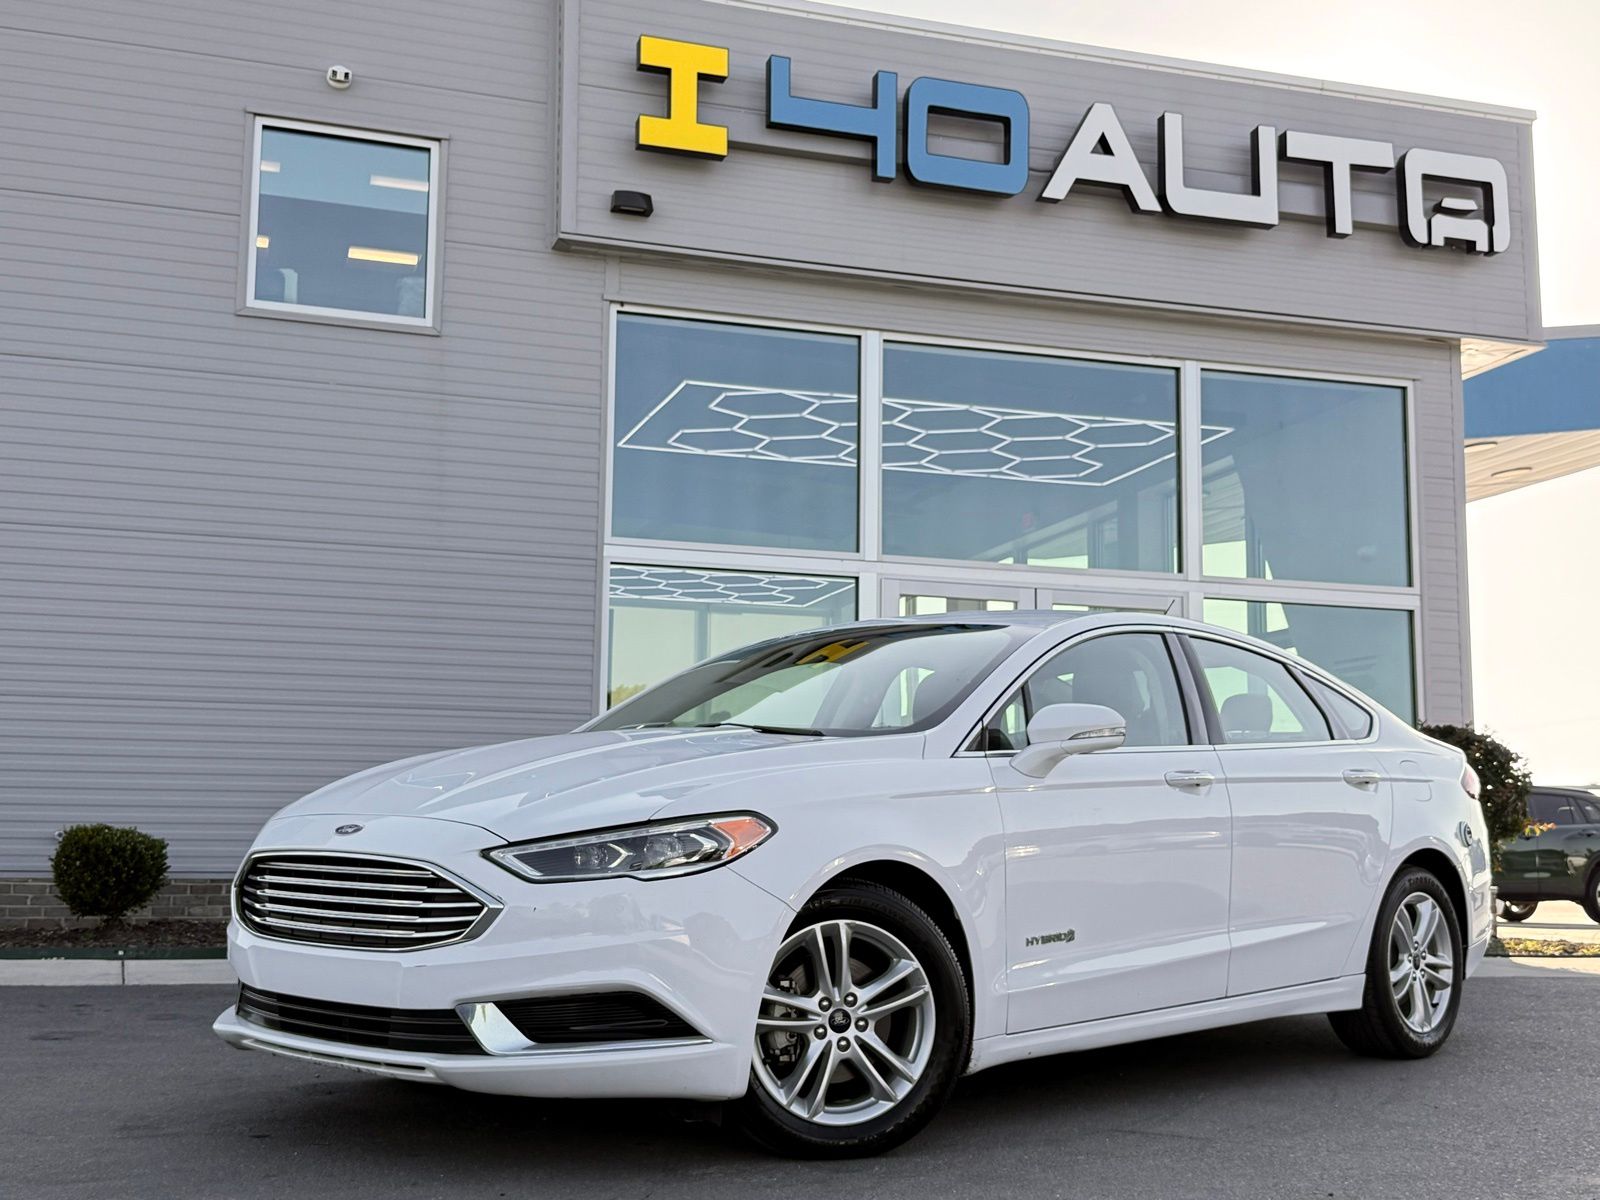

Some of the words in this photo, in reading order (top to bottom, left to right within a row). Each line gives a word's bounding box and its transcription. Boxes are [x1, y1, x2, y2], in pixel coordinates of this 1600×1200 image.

[636, 35, 729, 160] I
[766, 54, 1030, 198] 40
[1025, 932, 1067, 947] HYBRID
